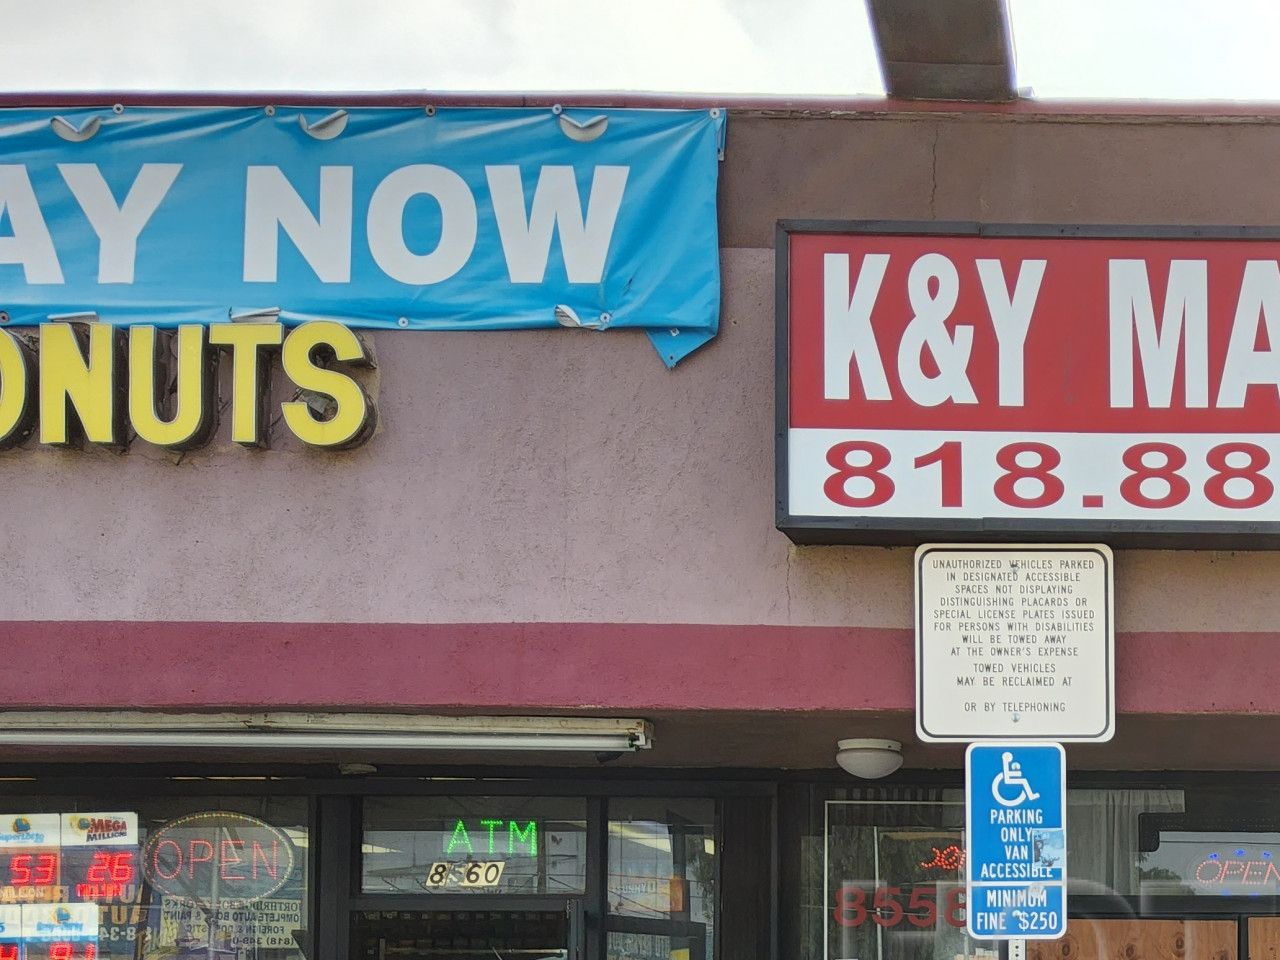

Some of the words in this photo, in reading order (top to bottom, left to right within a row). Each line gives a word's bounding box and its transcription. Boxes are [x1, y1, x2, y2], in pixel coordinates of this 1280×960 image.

[243, 164, 630, 285] NOW
[823, 252, 1047, 407] K&Y
[933, 560, 1002, 568] UNAUTHORIZED
[1009, 560, 1053, 569] VEHICLES
[1060, 560, 1094, 569] PARKED
[947, 573, 956, 581] IN
[964, 573, 1018, 581] DESIGNATED
[1025, 573, 1080, 581] ACCESSIBLE
[955, 585, 989, 593] SPACES
[996, 585, 1012, 593] NOT
[1020, 585, 1073, 594] DISPLAYING
[941, 598, 1014, 606] DISTINGUISHING
[1022, 598, 1068, 606] PLACARDS
[1075, 598, 1087, 606] OR
[934, 610, 971, 618] SPECIAL
[978, 610, 1015, 618] LICENSE
[1023, 610, 1054, 618] PLATES
[934, 623, 951, 631] FOR
[959, 623, 1000, 631] PERSONS
[1007, 623, 1028, 631] WITH
[1035, 623, 1094, 631] DISABILITIES
[962, 635, 983, 643] WILL
[990, 635, 1001, 643] BE
[1009, 635, 1037, 643] TOWED
[1045, 635, 1066, 643] AWAY
[951, 648, 960, 656] AT
[967, 648, 983, 656] THE
[991, 648, 1031, 656] OWNER'S
[1039, 648, 1078, 656] EXPENSE
[974, 664, 1004, 672] TOWED
[1012, 664, 1056, 672] VEHICLES
[957, 677, 975, 686] MAY
[983, 677, 994, 686] BE
[1002, 677, 1055, 686] RECLAIMED
[1063, 677, 1072, 686] AT
[965, 703, 976, 711] OR
[984, 703, 995, 711] BY
[1003, 703, 1065, 711] TELEPHONING
[990, 809, 1043, 824] PARKING
[447, 820, 537, 856] ATM
[1001, 827, 1033, 842] ONLY
[152, 840, 280, 880] OPEN
[1005, 846, 1028, 860] VAN
[10, 853, 57, 884] 53
[88, 851, 134, 883] 26
[430, 864, 499, 884] 860
[981, 864, 1053, 878] ACCESSIBLE
[987, 890, 1047, 907] MINIMUM
[977, 913, 1006, 930] FINE
[1018, 912, 1057, 931] $250
